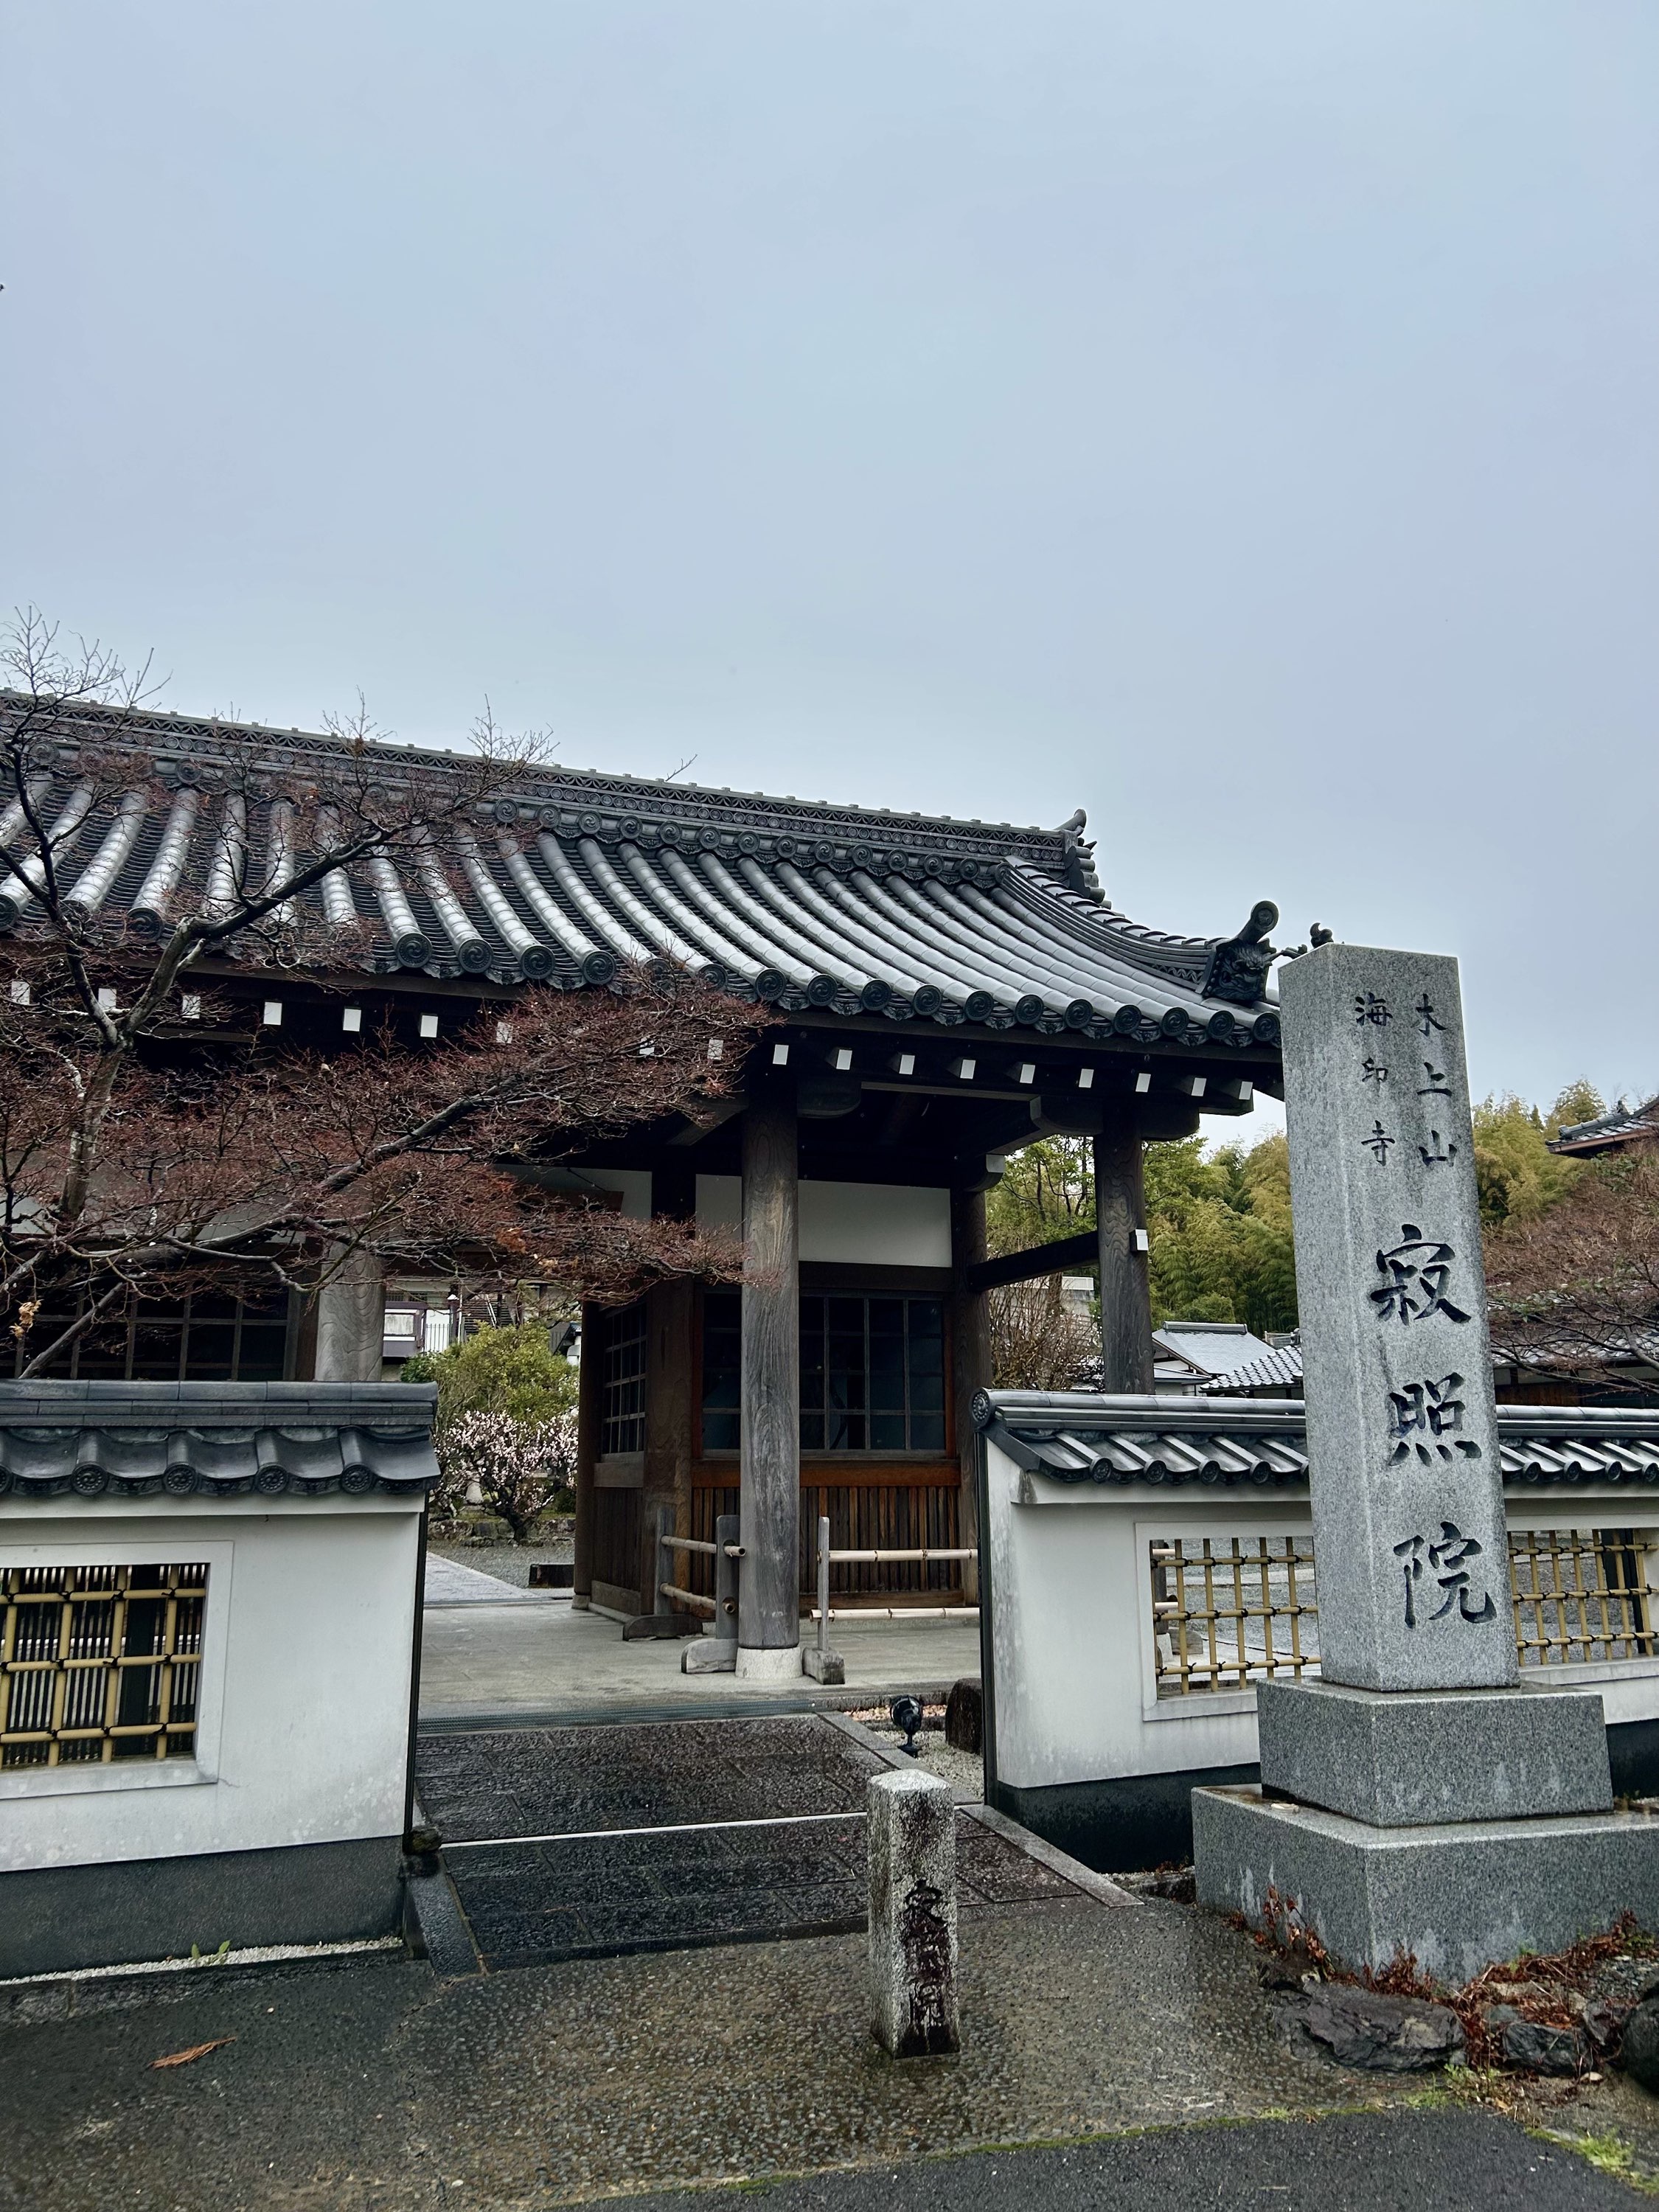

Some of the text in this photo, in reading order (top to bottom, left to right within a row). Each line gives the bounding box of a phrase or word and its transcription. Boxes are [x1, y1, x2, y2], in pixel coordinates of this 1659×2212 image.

[1354, 992, 1396, 1167] 海印寺
[1369, 1223, 1498, 1630] 寂照院
